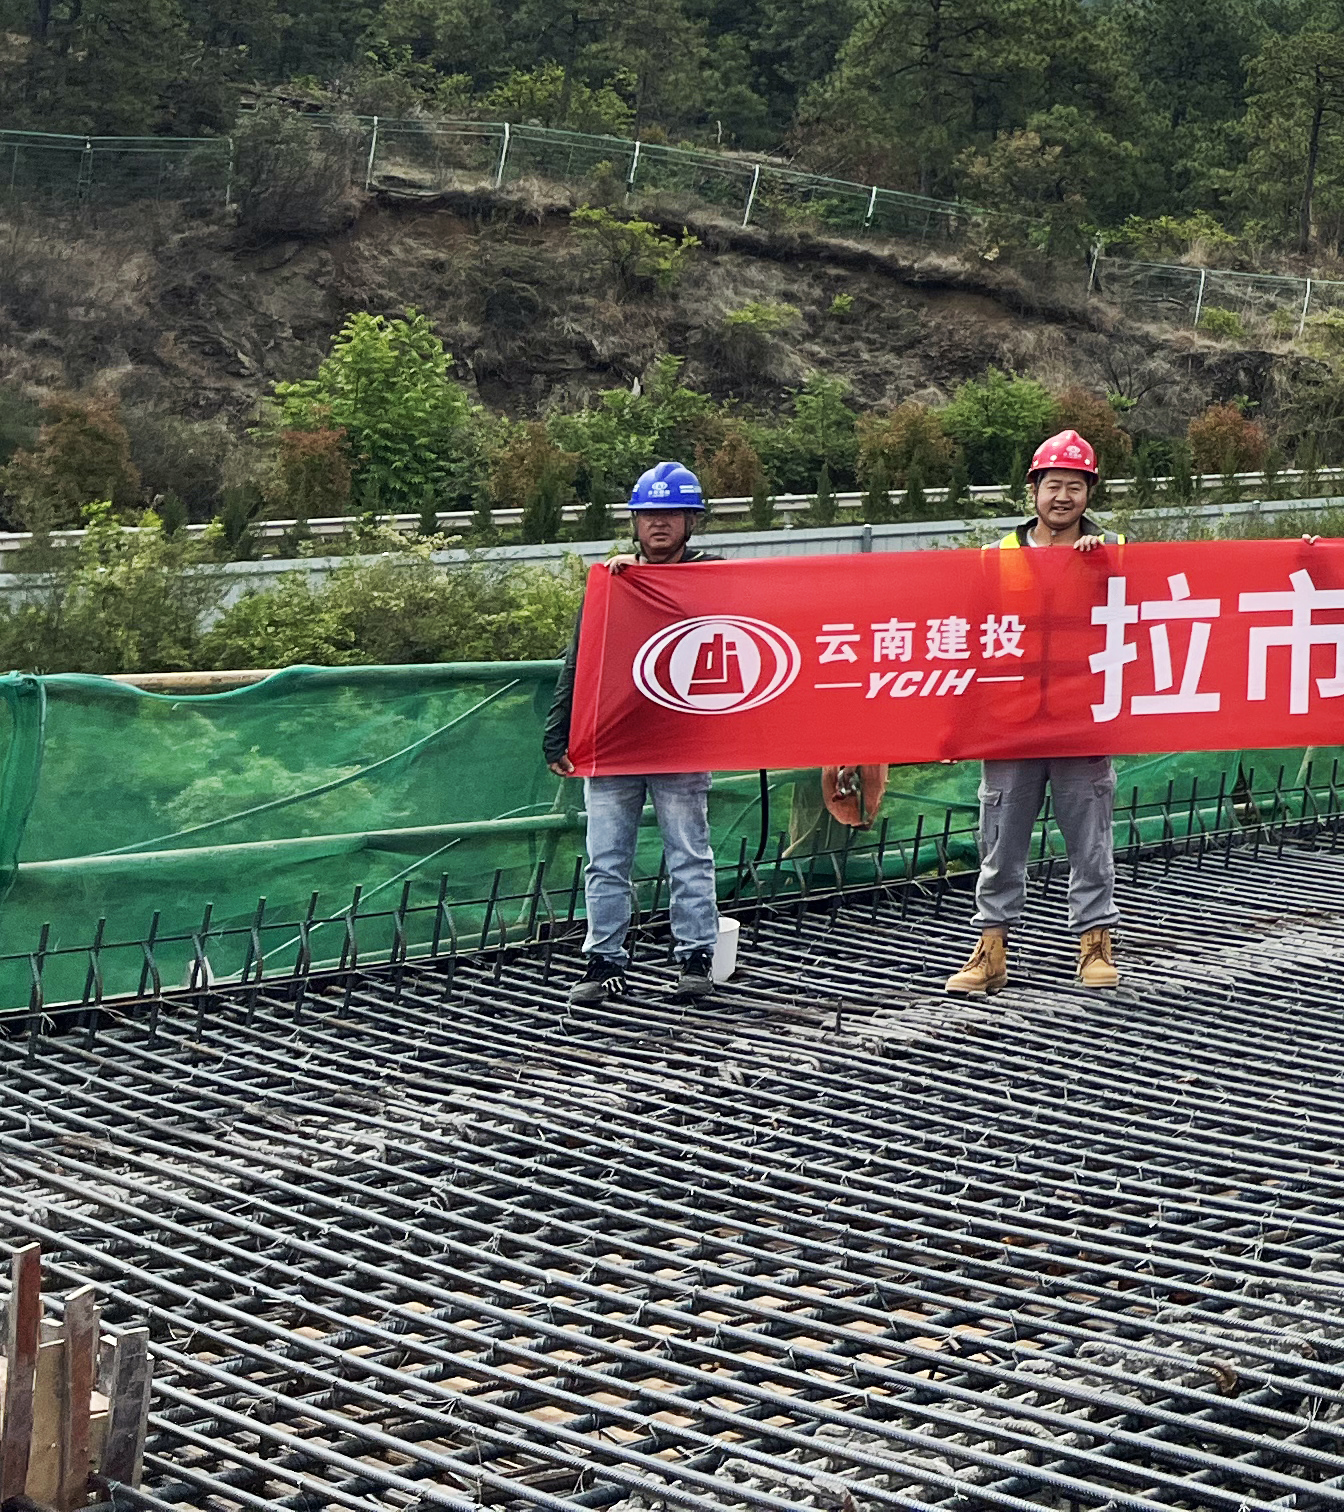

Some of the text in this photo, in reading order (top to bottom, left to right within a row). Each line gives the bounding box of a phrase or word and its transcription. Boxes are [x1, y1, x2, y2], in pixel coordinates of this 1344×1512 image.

[815, 614, 1026, 665] 云南建投
[866, 669, 977, 698] YCIH
